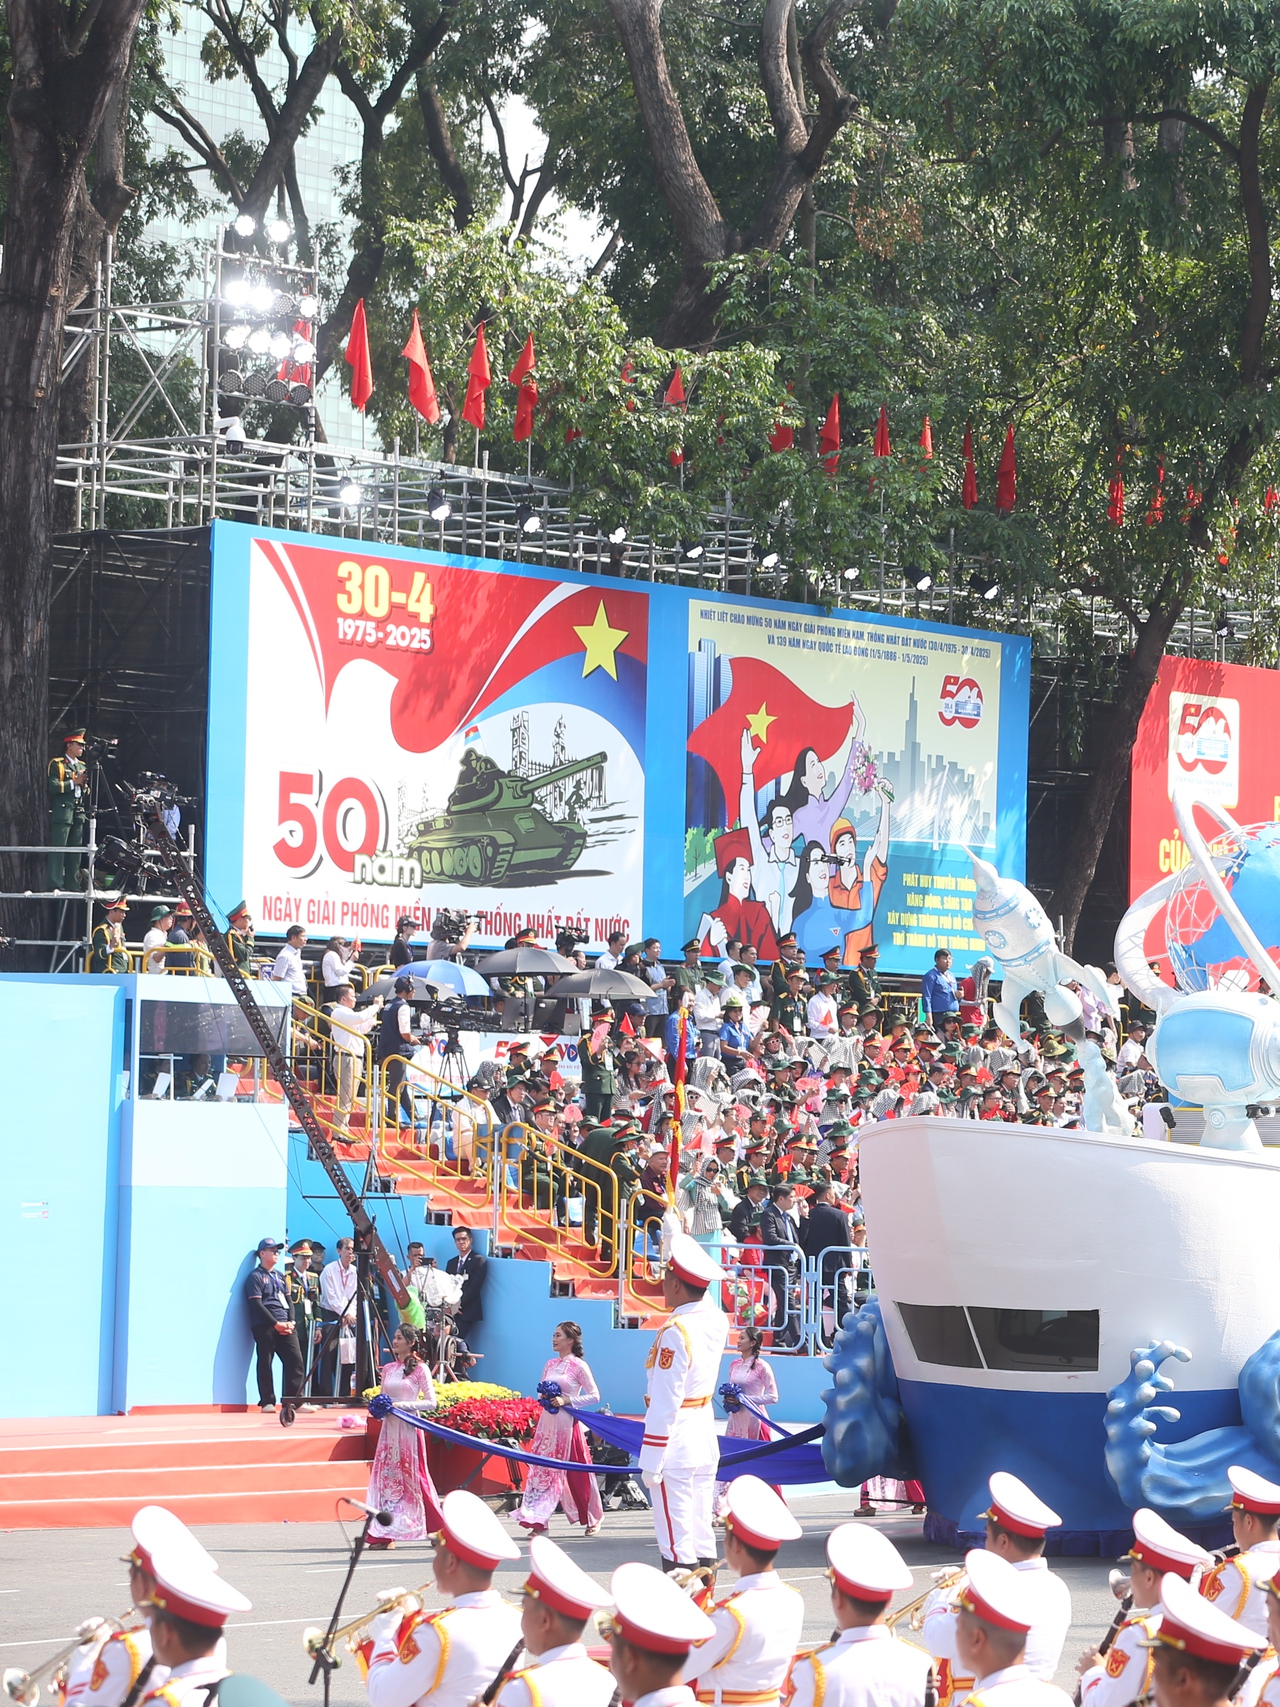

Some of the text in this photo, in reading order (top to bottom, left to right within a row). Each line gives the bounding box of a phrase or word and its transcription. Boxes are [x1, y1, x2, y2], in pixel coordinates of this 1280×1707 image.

[337, 561, 435, 624] 30-4
[717, 610, 728, 623] LIỆT
[730, 611, 745, 625] CHÀO
[764, 617, 772, 628] 50
[788, 619, 802, 632] NGÀY
[817, 623, 836, 636] PHÓNG
[768, 634, 775, 645] VÀ
[777, 636, 787, 647] 139
[272, 771, 423, 889] 50 năm
[263, 892, 302, 922] NGÀY
[307, 891, 336, 925] GIẢI
[341, 897, 390, 929] PHÓNG
[595, 913, 630, 942] NƯỚC
